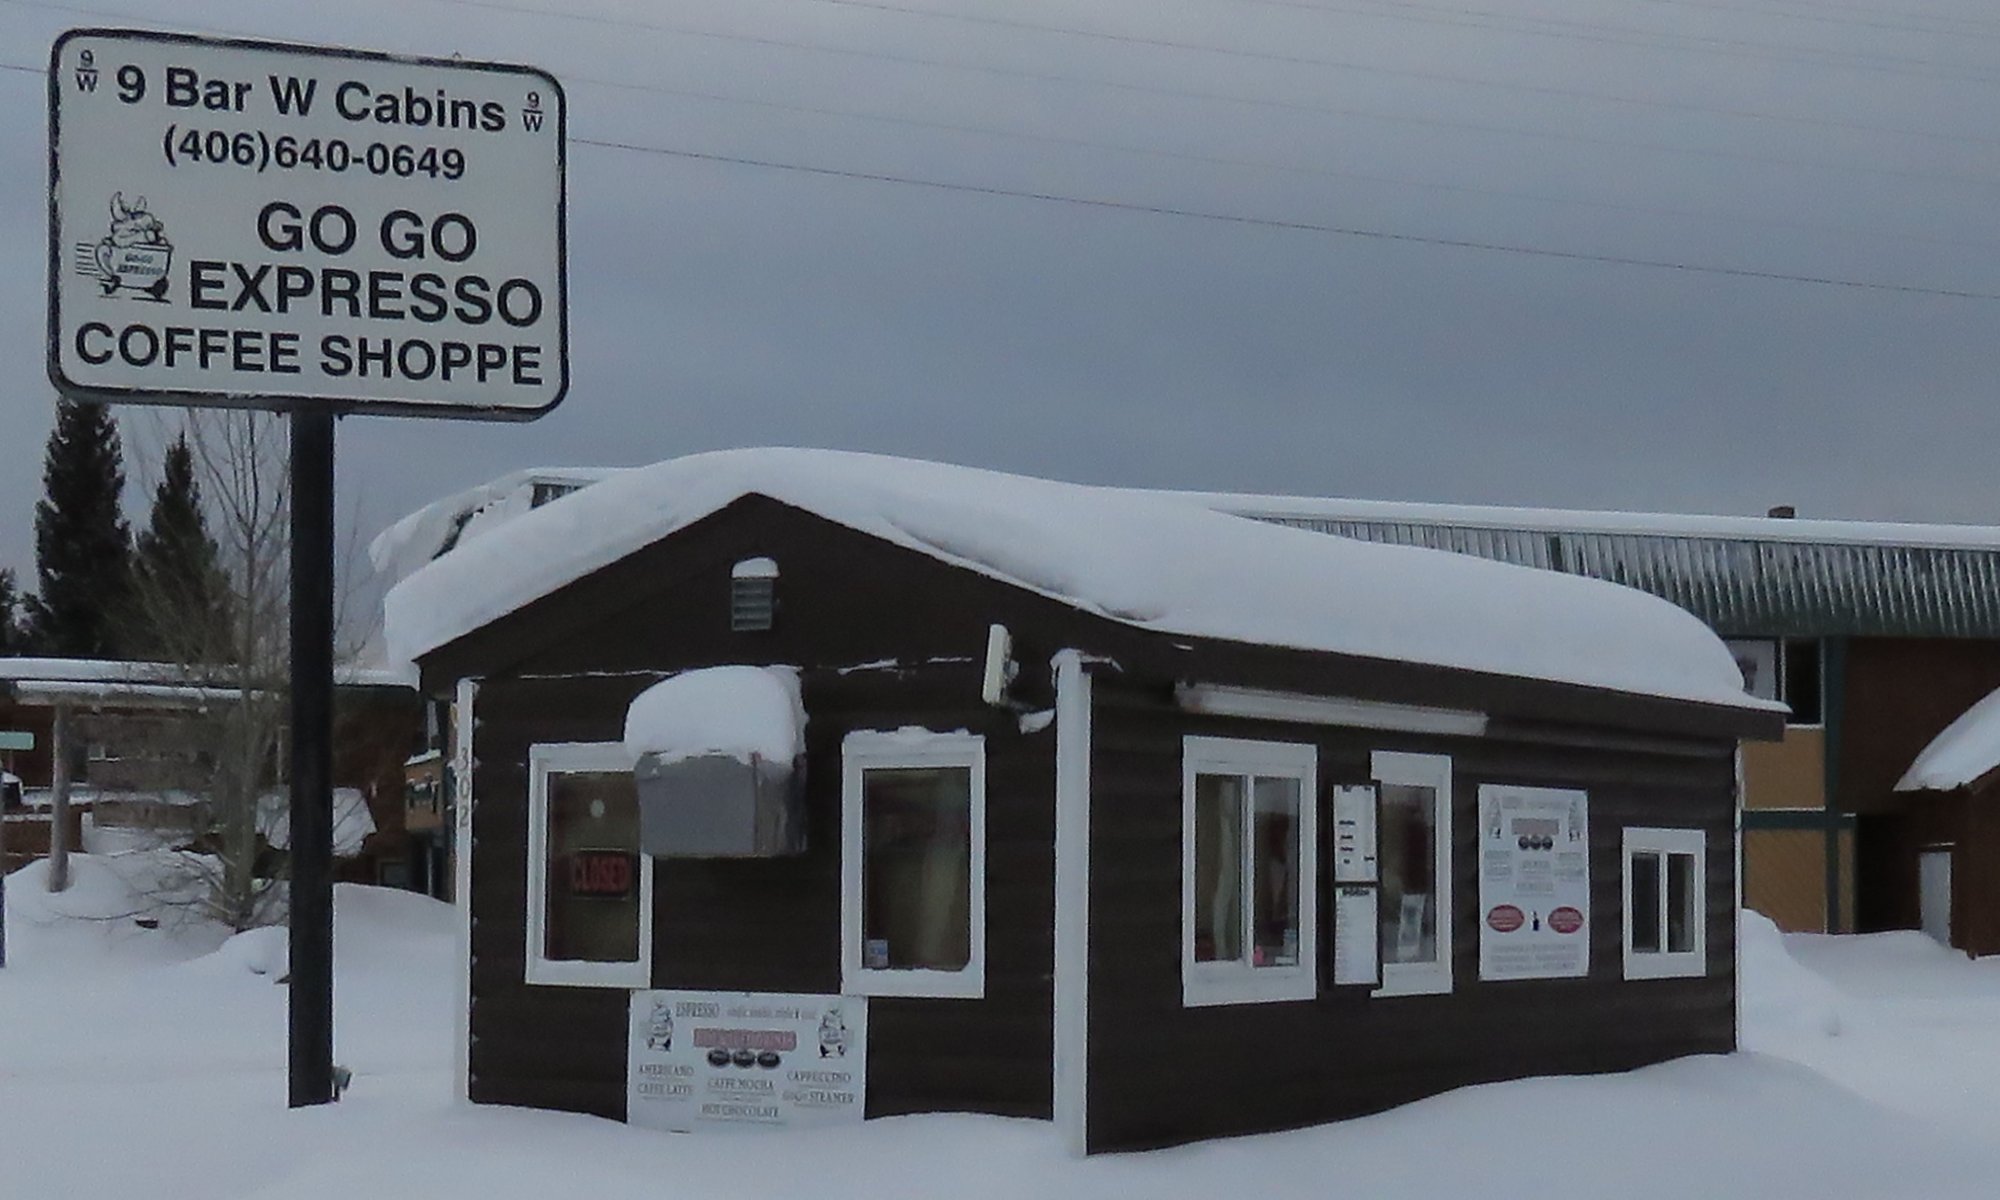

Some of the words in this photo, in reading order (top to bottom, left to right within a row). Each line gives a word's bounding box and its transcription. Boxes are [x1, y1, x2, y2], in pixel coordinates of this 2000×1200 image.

[76, 71, 98, 93] W
[80, 50, 95, 69] 9
[116, 64, 146, 105] 9
[166, 66, 252, 113] Bar
[268, 75, 317, 117] W
[335, 80, 507, 132] Cabins
[526, 91, 541, 109] 9
[522, 113, 544, 133] W
[163, 123, 466, 181] (406)640-0649
[257, 200, 357, 256] GO
[379, 209, 478, 262] GO
[189, 259, 544, 328] EXPRESSO
[74, 321, 302, 374] COFFEE
[319, 335, 544, 386] SHOPPE
[571, 856, 629, 892] CLOSED
